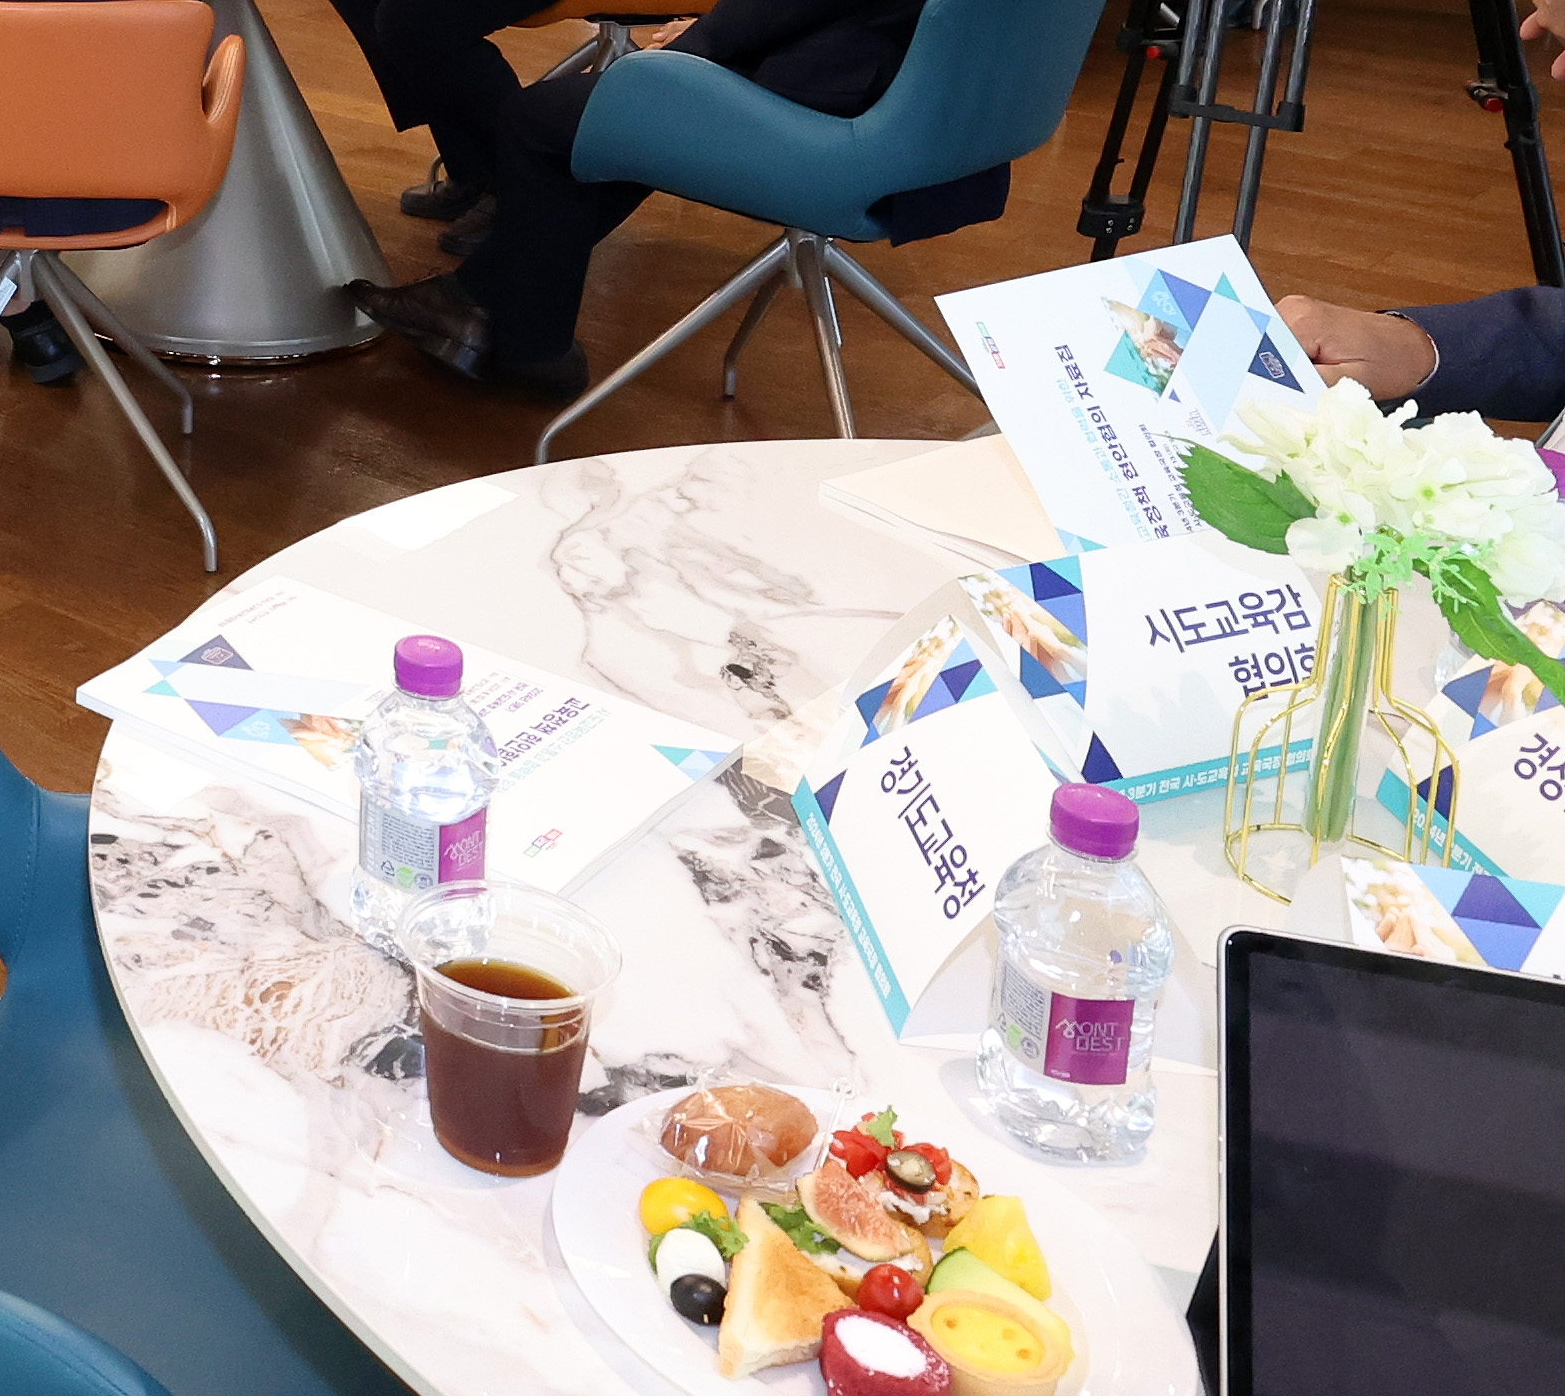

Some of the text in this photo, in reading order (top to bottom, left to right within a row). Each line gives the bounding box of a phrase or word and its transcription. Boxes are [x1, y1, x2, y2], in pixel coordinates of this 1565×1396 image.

[1053, 344, 1095, 400] 자료집
[1086, 405, 1139, 481] 현안협의
[1115, 487, 1153, 542] 교육청간
[1144, 583, 1312, 654] 시도교육감
[529, 696, 591, 736] 교육정책
[1513, 732, 1565, 802] 경상
[879, 744, 986, 920] 경기도교육청
[1413, 807, 1447, 848] 204년
[1075, 1036, 1126, 1053] BEST
